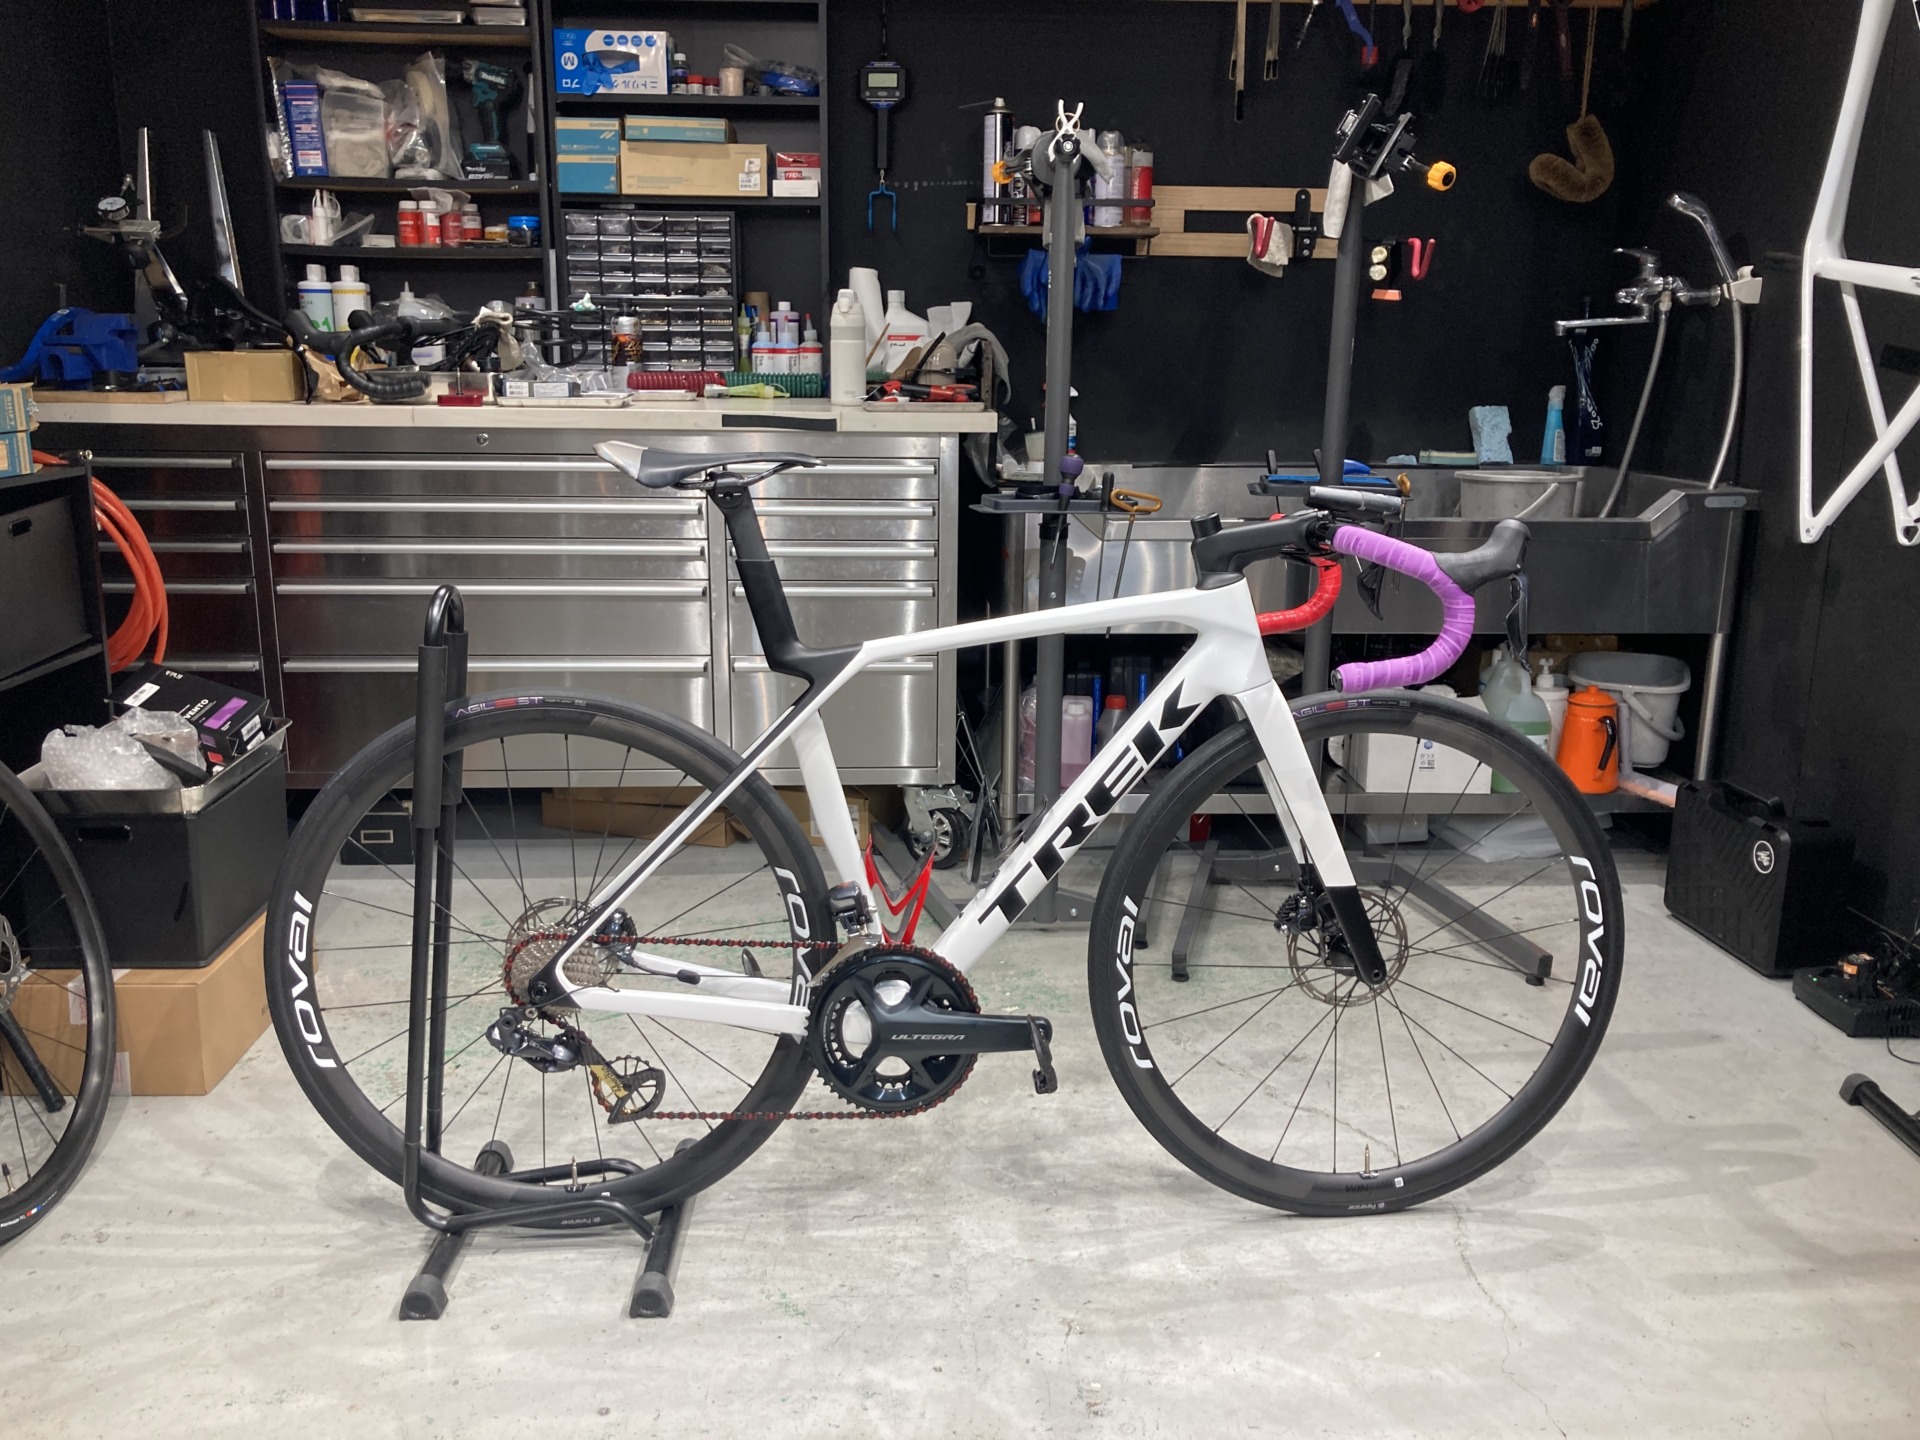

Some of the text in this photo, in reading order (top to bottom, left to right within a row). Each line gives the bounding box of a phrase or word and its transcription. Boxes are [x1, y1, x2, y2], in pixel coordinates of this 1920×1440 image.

[455, 696, 544, 718] AGILEST
[978, 677, 1202, 925] TREK
[288, 890, 337, 1068] roval
[1116, 895, 1153, 1068] roval
[1569, 855, 1605, 1027] roval
[891, 1033, 966, 1041] ULTEGRA
